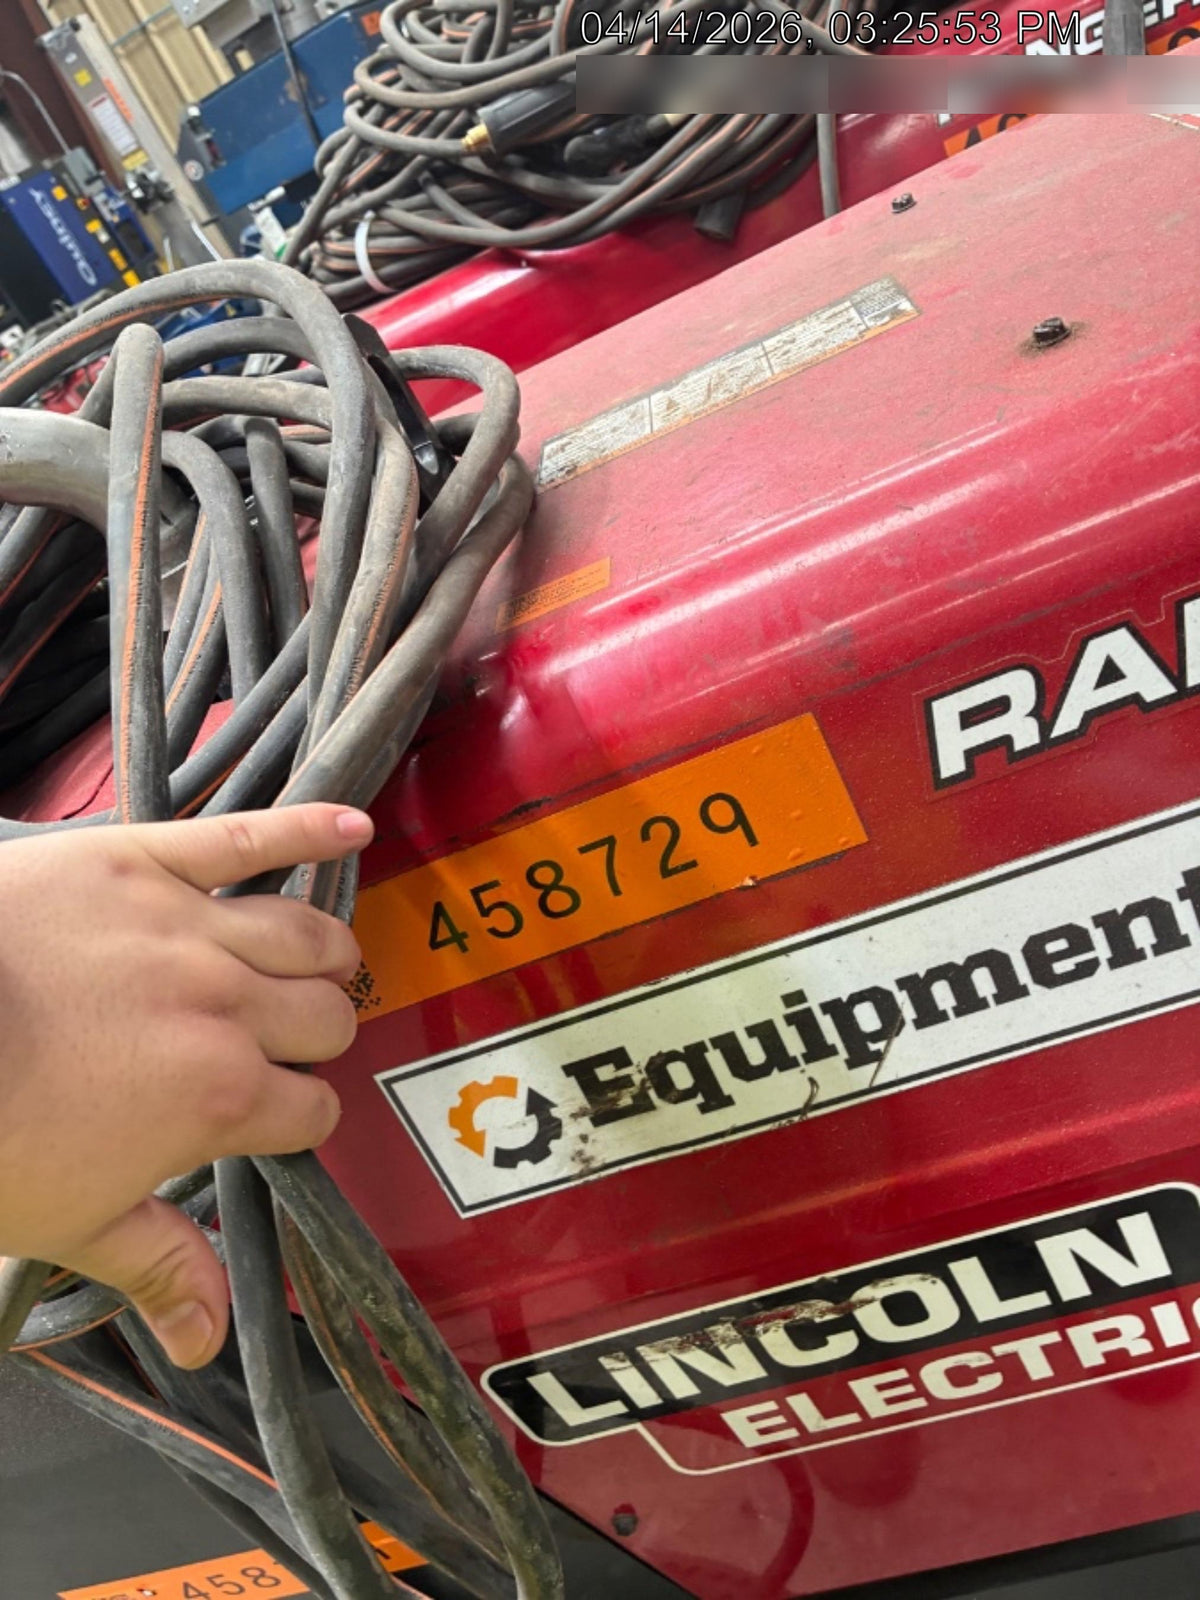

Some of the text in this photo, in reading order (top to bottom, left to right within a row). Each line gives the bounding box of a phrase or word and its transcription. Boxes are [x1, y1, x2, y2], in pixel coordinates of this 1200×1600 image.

[930, 598, 1200, 782] RA
[426, 792, 760, 956] 458729
[527, 1212, 1171, 1426] LINCOLN
[722, 1297, 1200, 1448] ELECTRI
